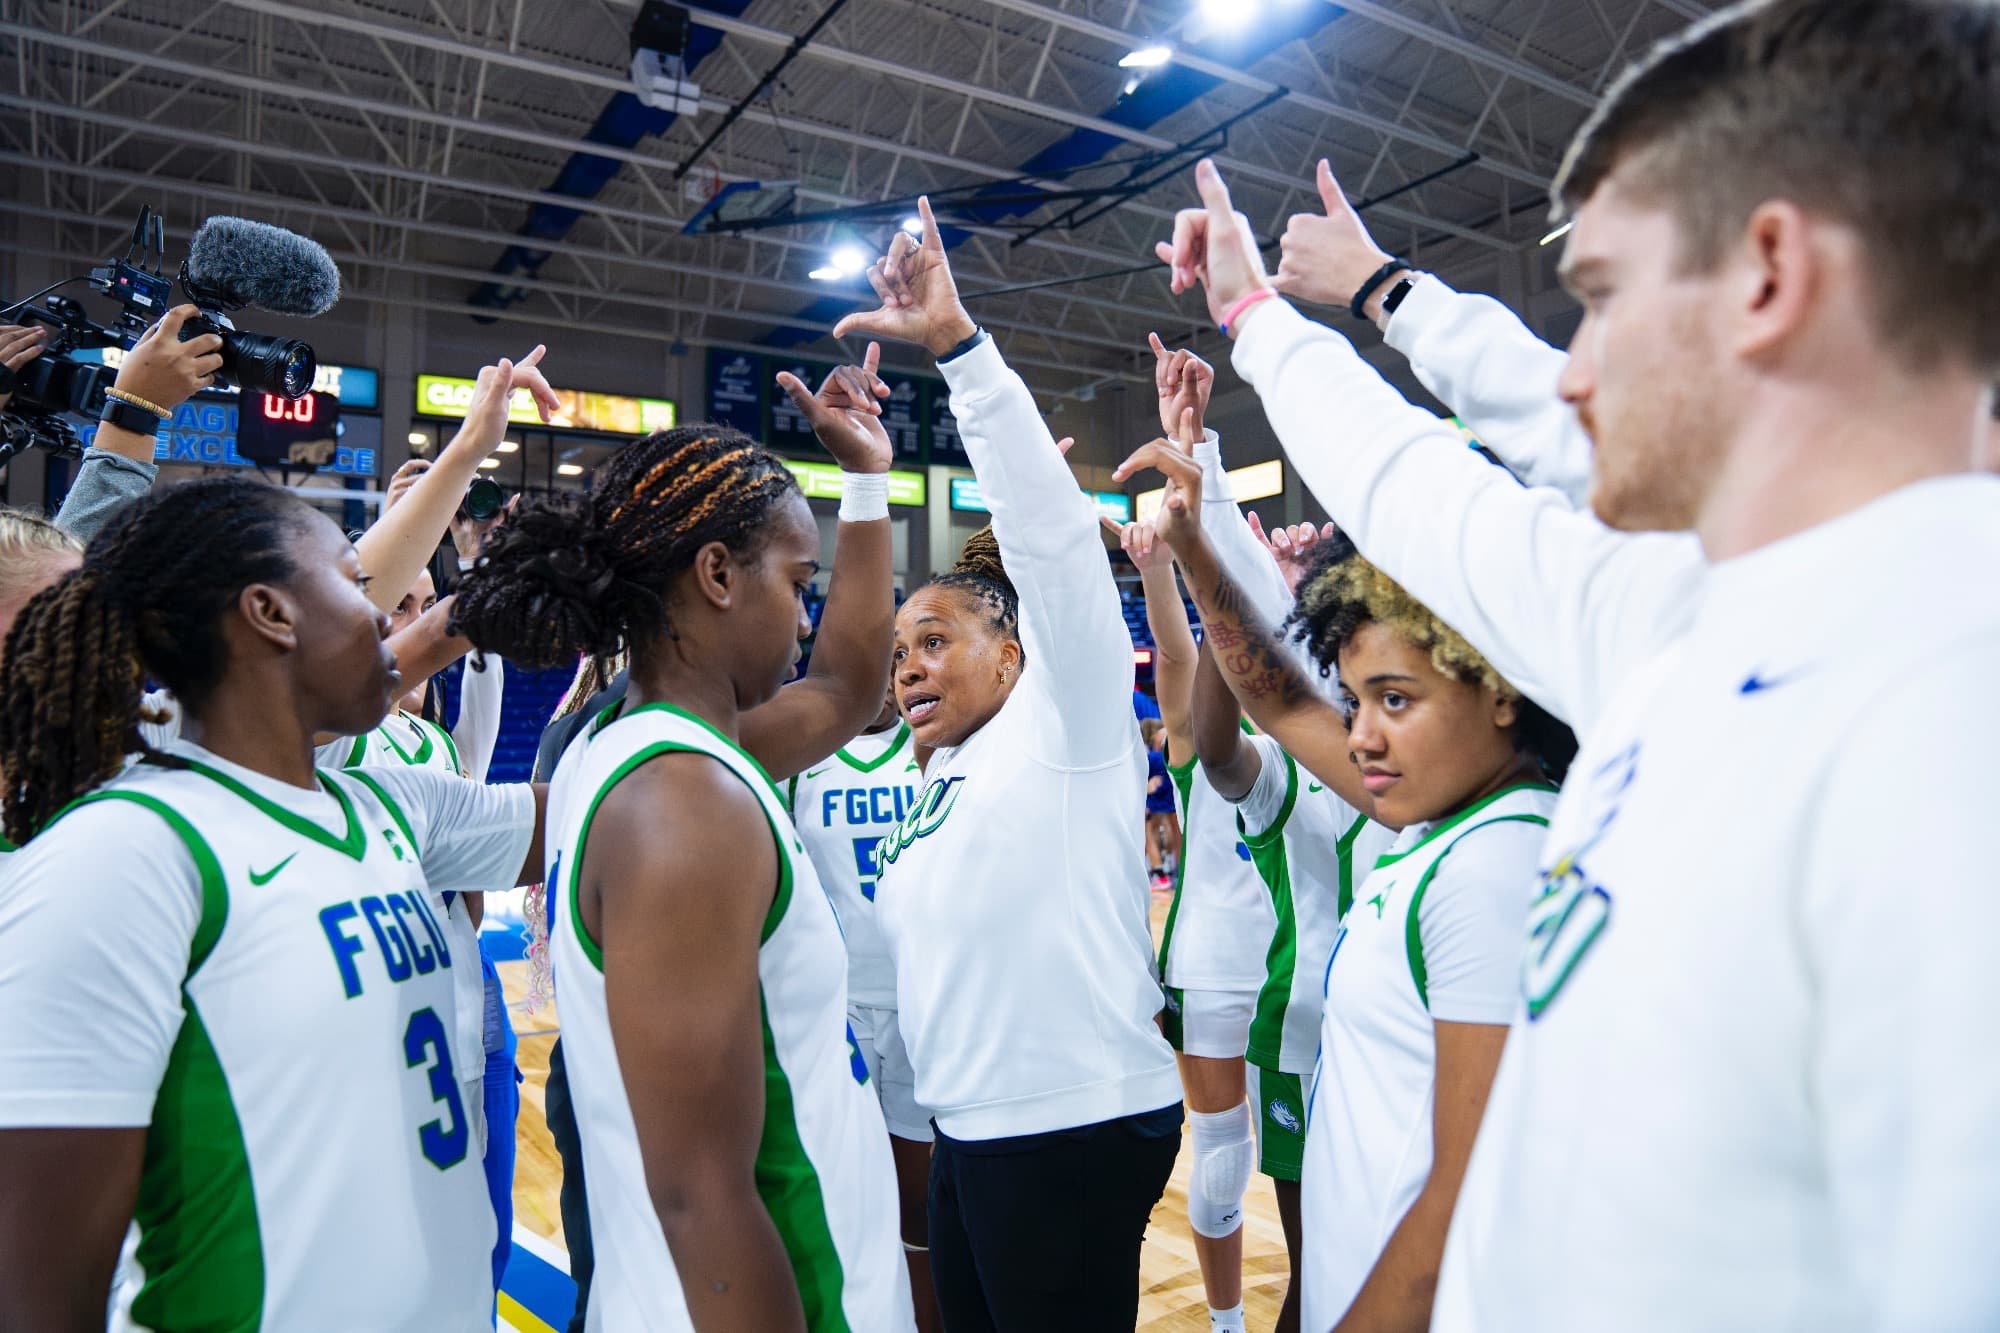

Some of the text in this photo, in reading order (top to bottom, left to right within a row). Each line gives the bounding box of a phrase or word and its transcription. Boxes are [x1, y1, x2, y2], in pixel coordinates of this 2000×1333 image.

[264, 392, 314, 422] 0.0
[822, 785, 915, 828] FGCU
[318, 889, 452, 1000] FGCU
[403, 1005, 470, 1172] 3
